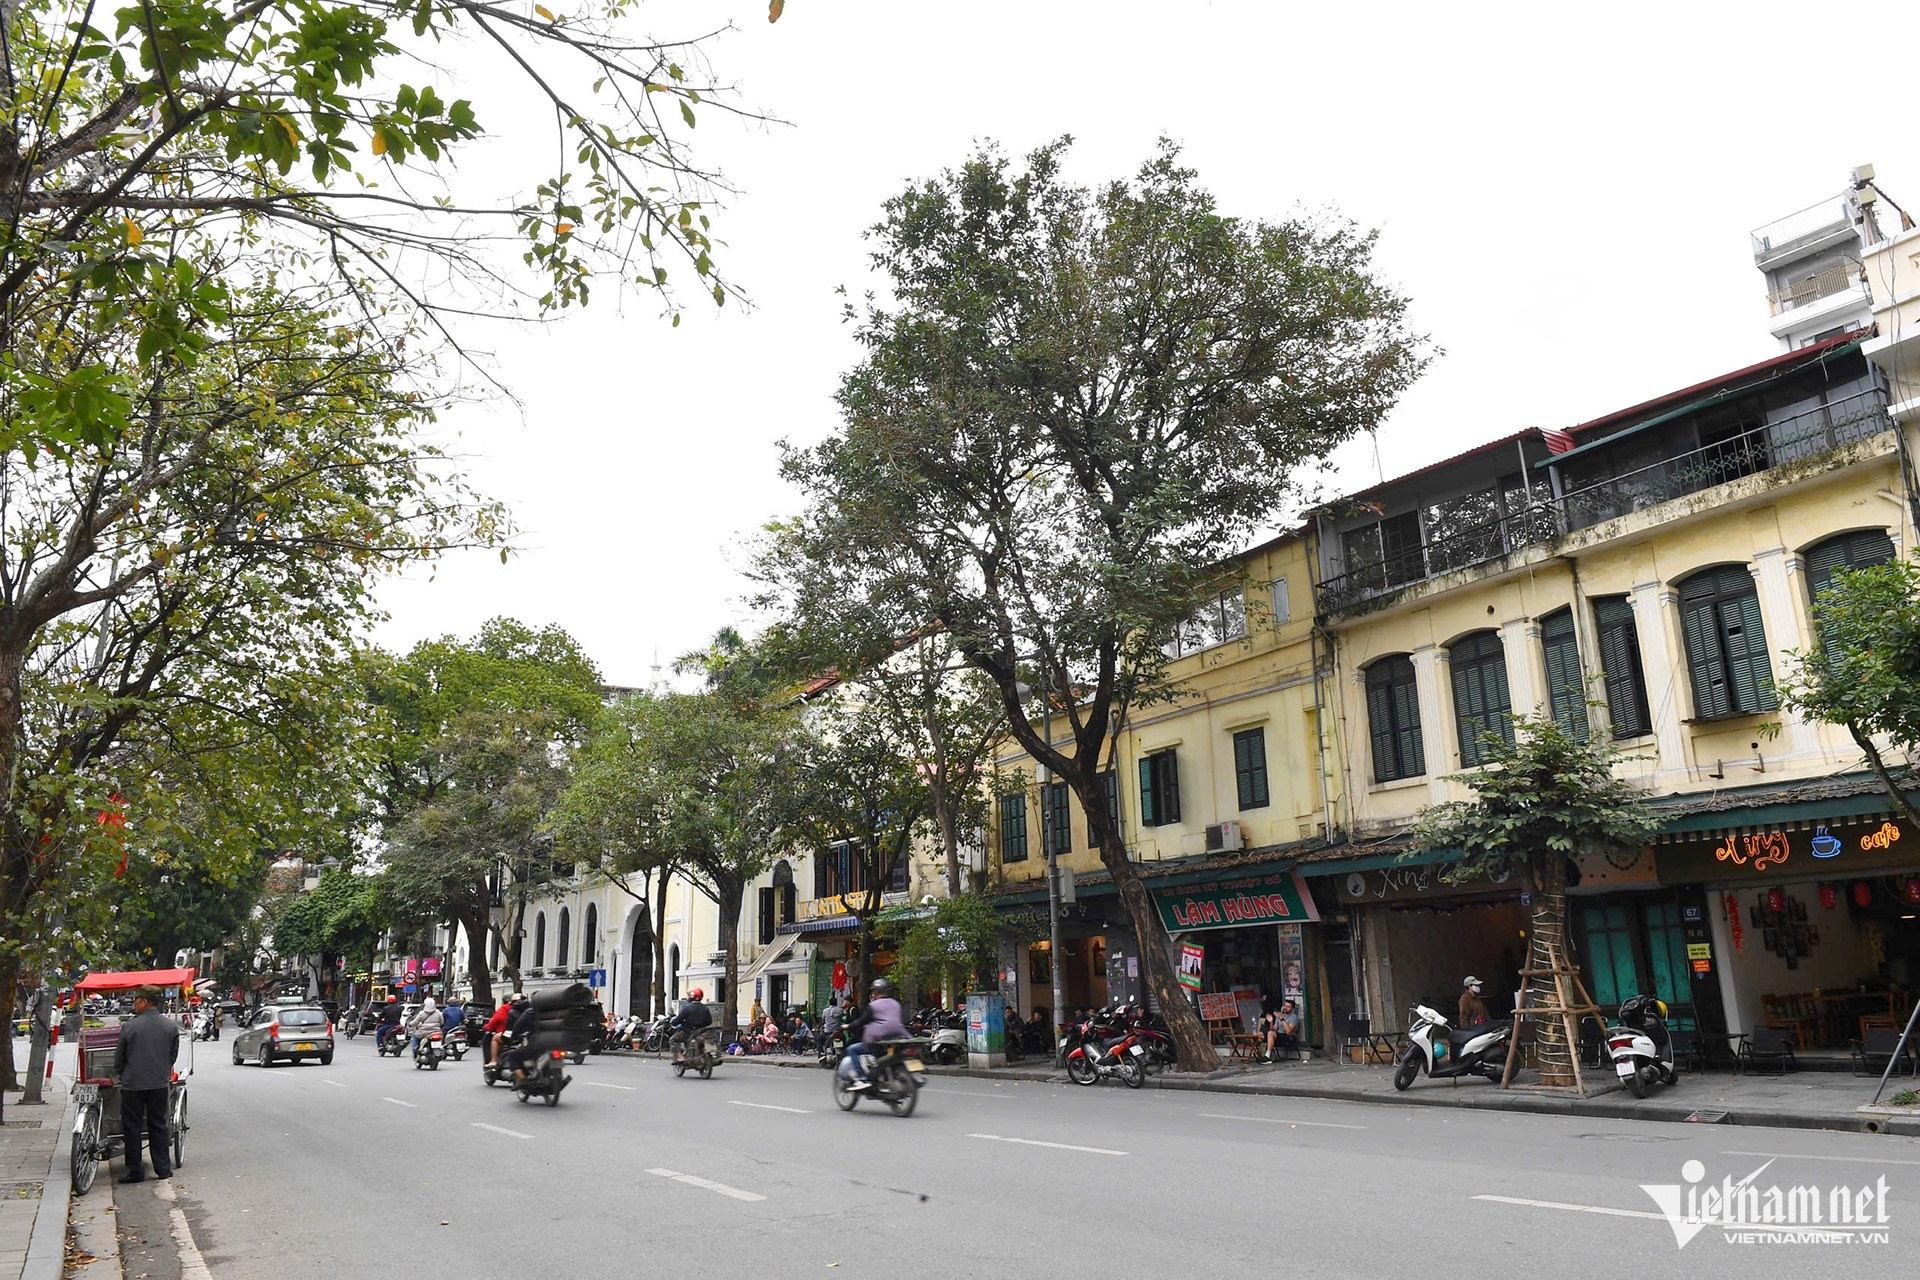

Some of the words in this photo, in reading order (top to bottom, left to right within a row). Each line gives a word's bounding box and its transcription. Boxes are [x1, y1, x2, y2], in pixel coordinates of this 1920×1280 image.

[1860, 822, 1901, 850] cafe
[1172, 898, 1221, 926] LÂM
[1222, 893, 1290, 923] HÙNG
[1686, 908, 1697, 917] 67
